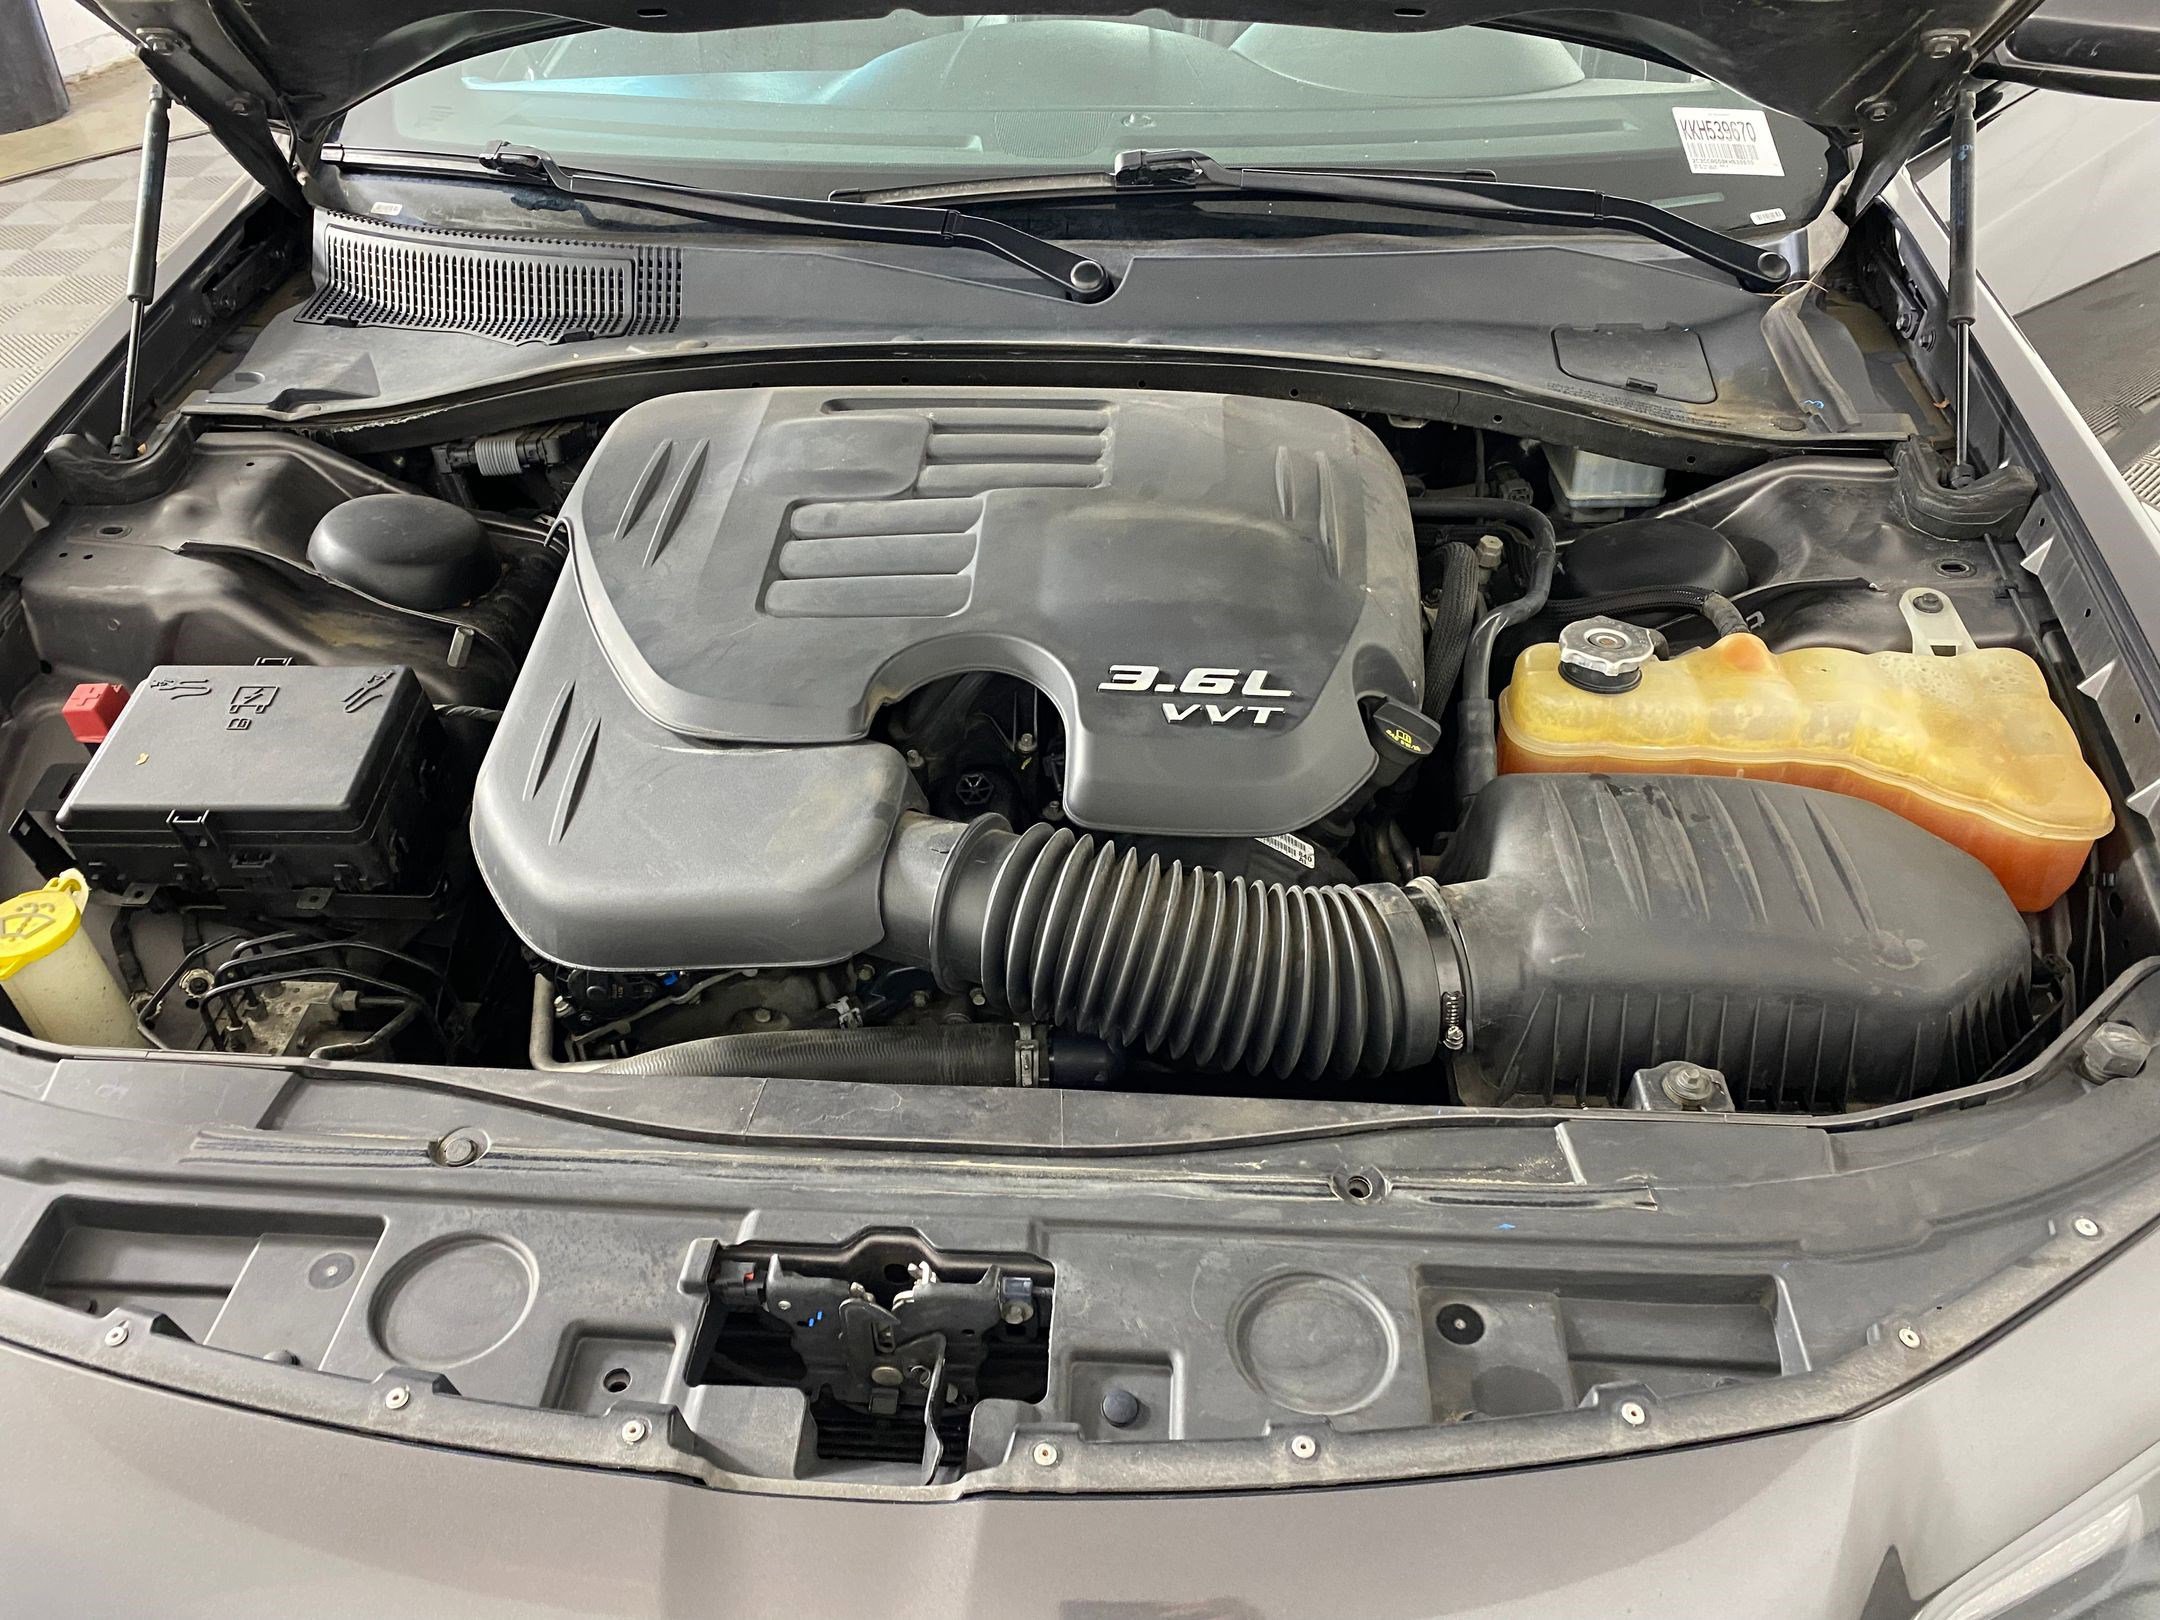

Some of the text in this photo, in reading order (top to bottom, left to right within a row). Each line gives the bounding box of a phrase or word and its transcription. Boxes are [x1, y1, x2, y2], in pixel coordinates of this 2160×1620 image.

[1680, 119, 1757, 143] KKH539670
[1097, 664, 1295, 698] 3.6L
[1161, 702, 1286, 726] VVT
